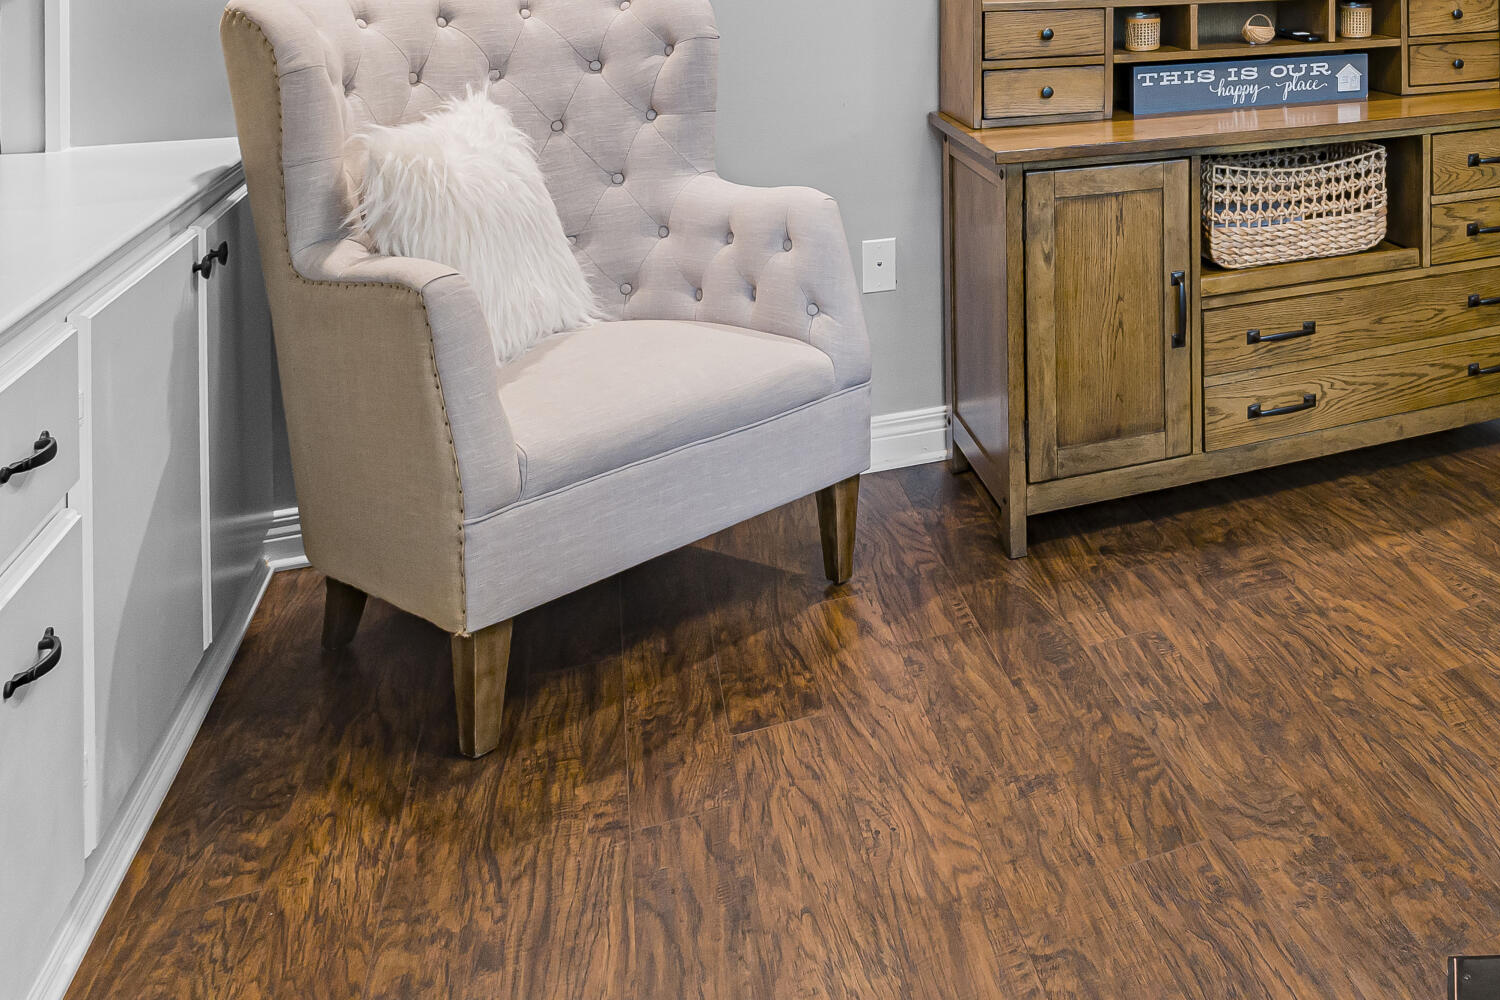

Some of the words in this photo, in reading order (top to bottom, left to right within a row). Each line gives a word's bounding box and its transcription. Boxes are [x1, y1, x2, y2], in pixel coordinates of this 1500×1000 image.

[1137, 69, 1215, 87] THIS
[1227, 66, 1258, 81] IS
[1270, 62, 1332, 78] OUR
[1209, 78, 1270, 105] happy
[1275, 72, 1328, 101] place
